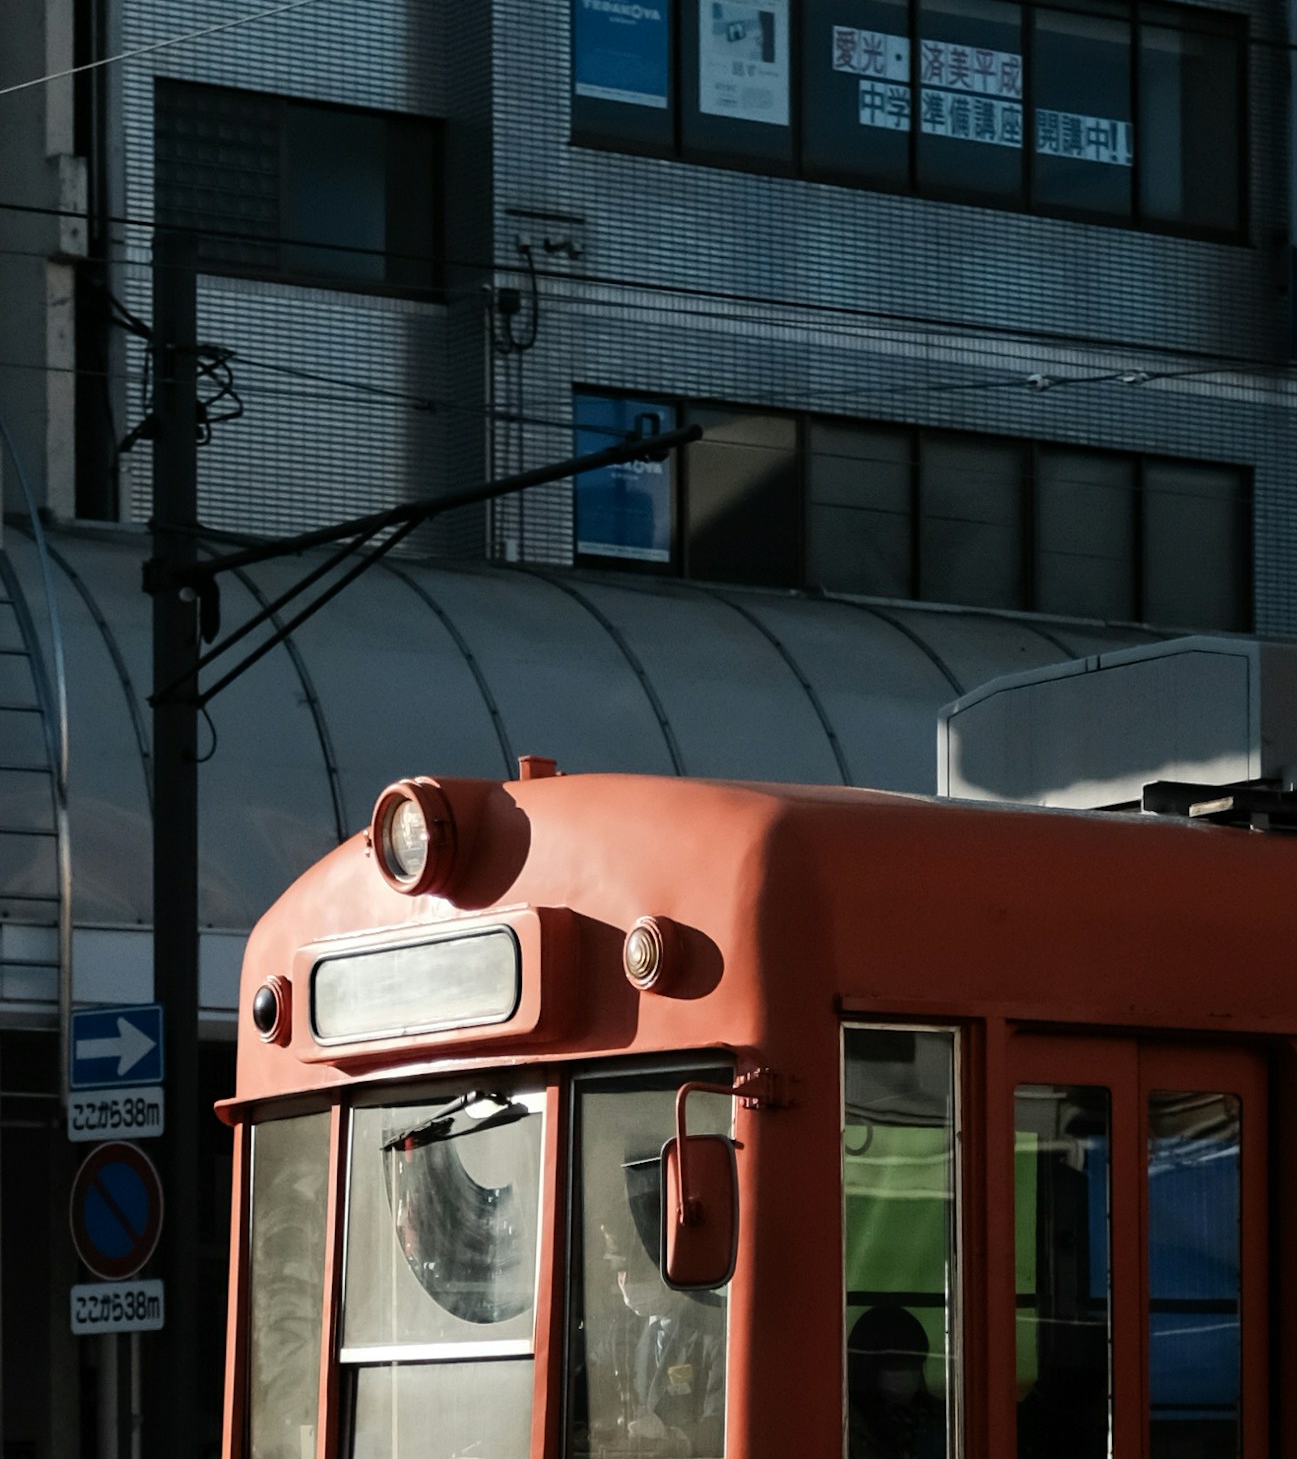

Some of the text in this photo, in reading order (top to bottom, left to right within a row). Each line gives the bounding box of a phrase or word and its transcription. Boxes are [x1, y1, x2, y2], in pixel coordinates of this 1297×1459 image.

[73, 1098, 160, 1130] ここから38m
[76, 1291, 160, 1323] ここから38m
